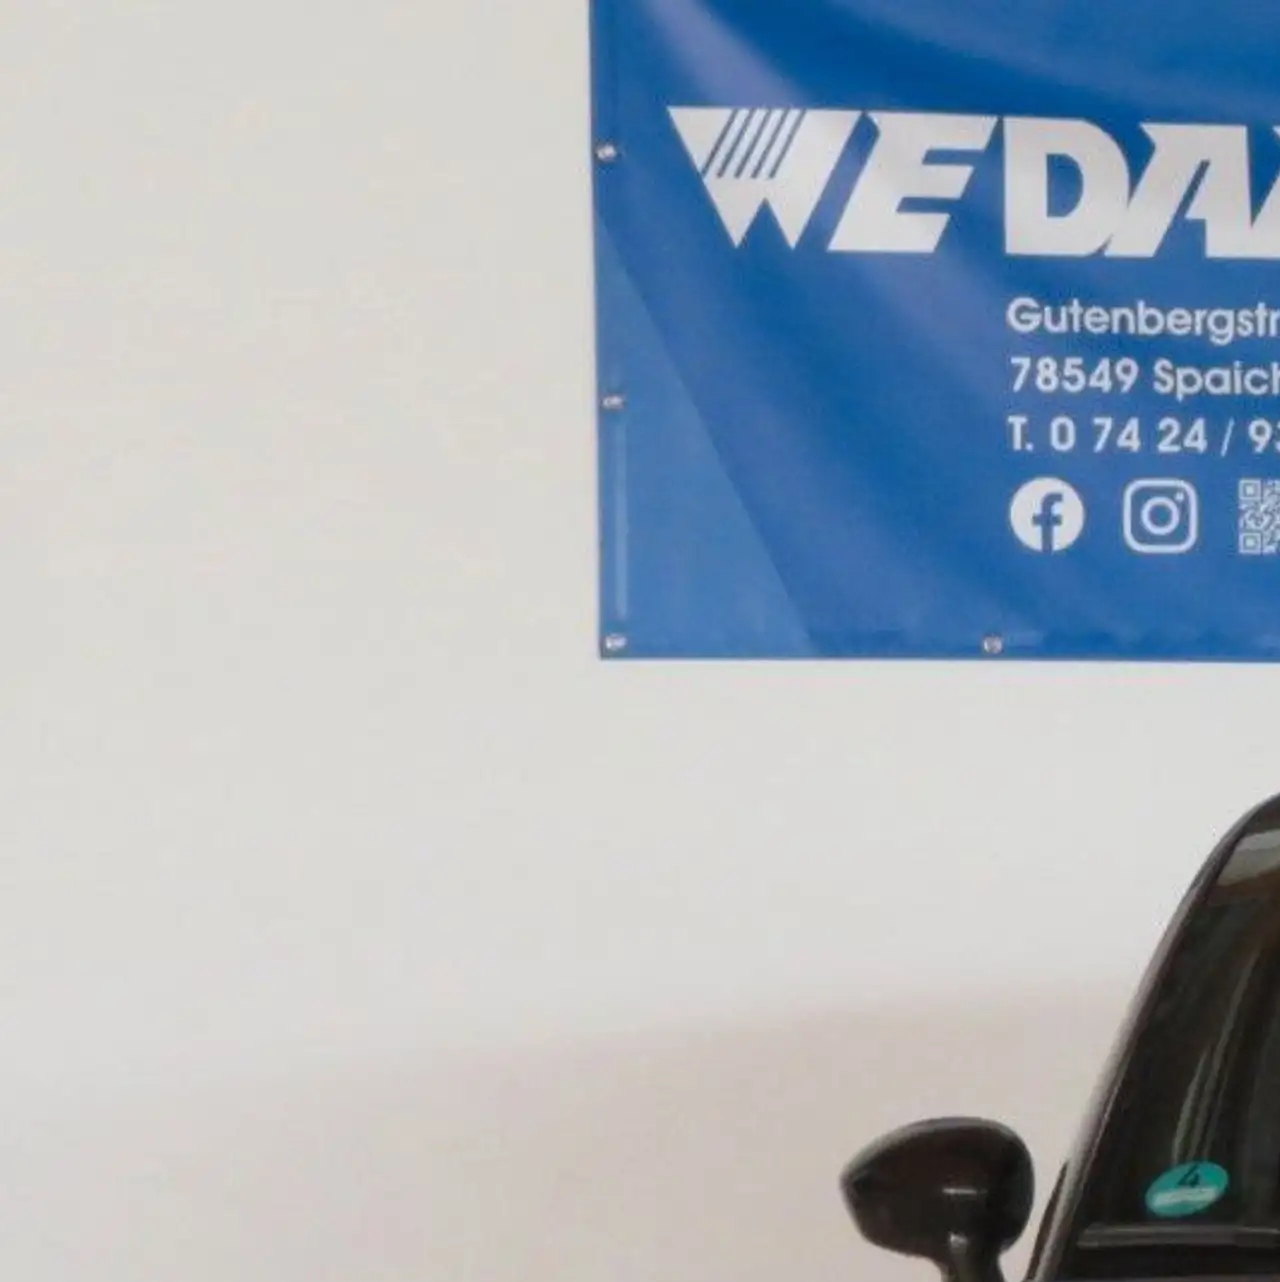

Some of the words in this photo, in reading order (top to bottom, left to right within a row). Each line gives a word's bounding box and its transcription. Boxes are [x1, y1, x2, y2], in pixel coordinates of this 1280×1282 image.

[1010, 356, 1140, 393] 78549
[1007, 415, 1034, 453] T.
[1049, 416, 1076, 453] 0
[1092, 416, 1142, 453] 74
[1156, 416, 1209, 454] 24
